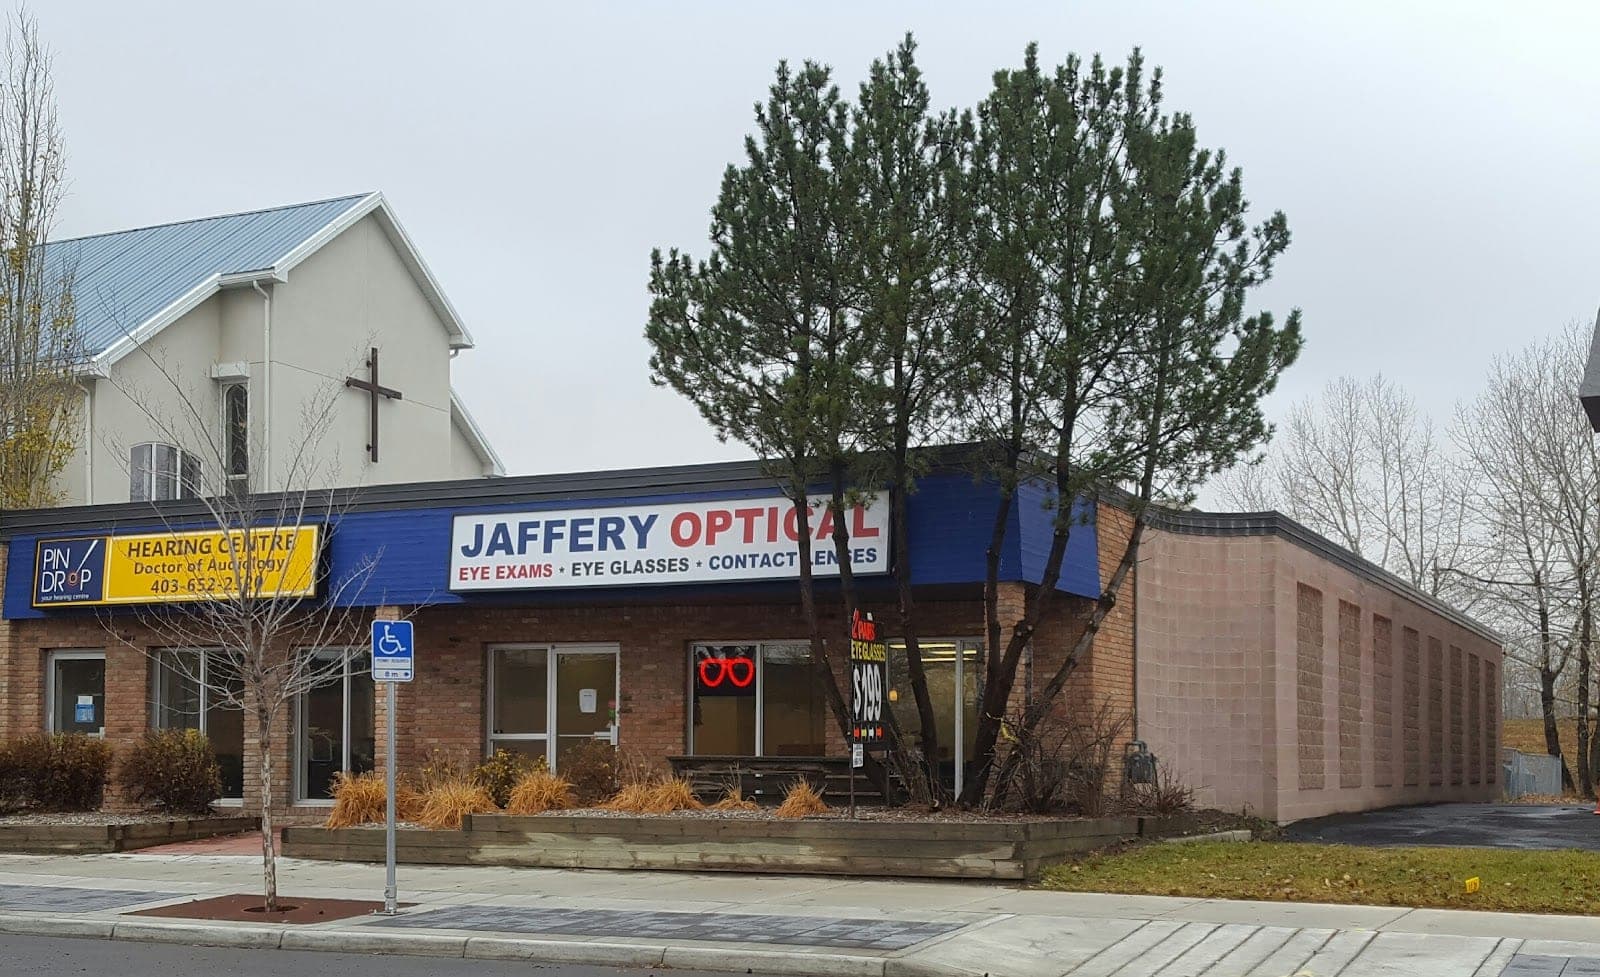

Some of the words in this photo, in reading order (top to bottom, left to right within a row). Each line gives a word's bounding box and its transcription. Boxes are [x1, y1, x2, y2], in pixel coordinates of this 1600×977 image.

[461, 514, 659, 557] JAFFERY
[670, 504, 879, 547] OPTICAL
[43, 547, 70, 571] PIN
[127, 538, 212, 557] HEARING
[134, 561, 183, 575] Doctor
[187, 558, 203, 573] of
[459, 566, 491, 581] EYE
[496, 563, 553, 580] EXAMS
[571, 561, 604, 577] EYE
[610, 557, 689, 575] GLASSES
[709, 551, 797, 570] CONTACT
[806, 547, 877, 566] ENES
[41, 569, 92, 593] DROP
[853, 664, 882, 722] $199
